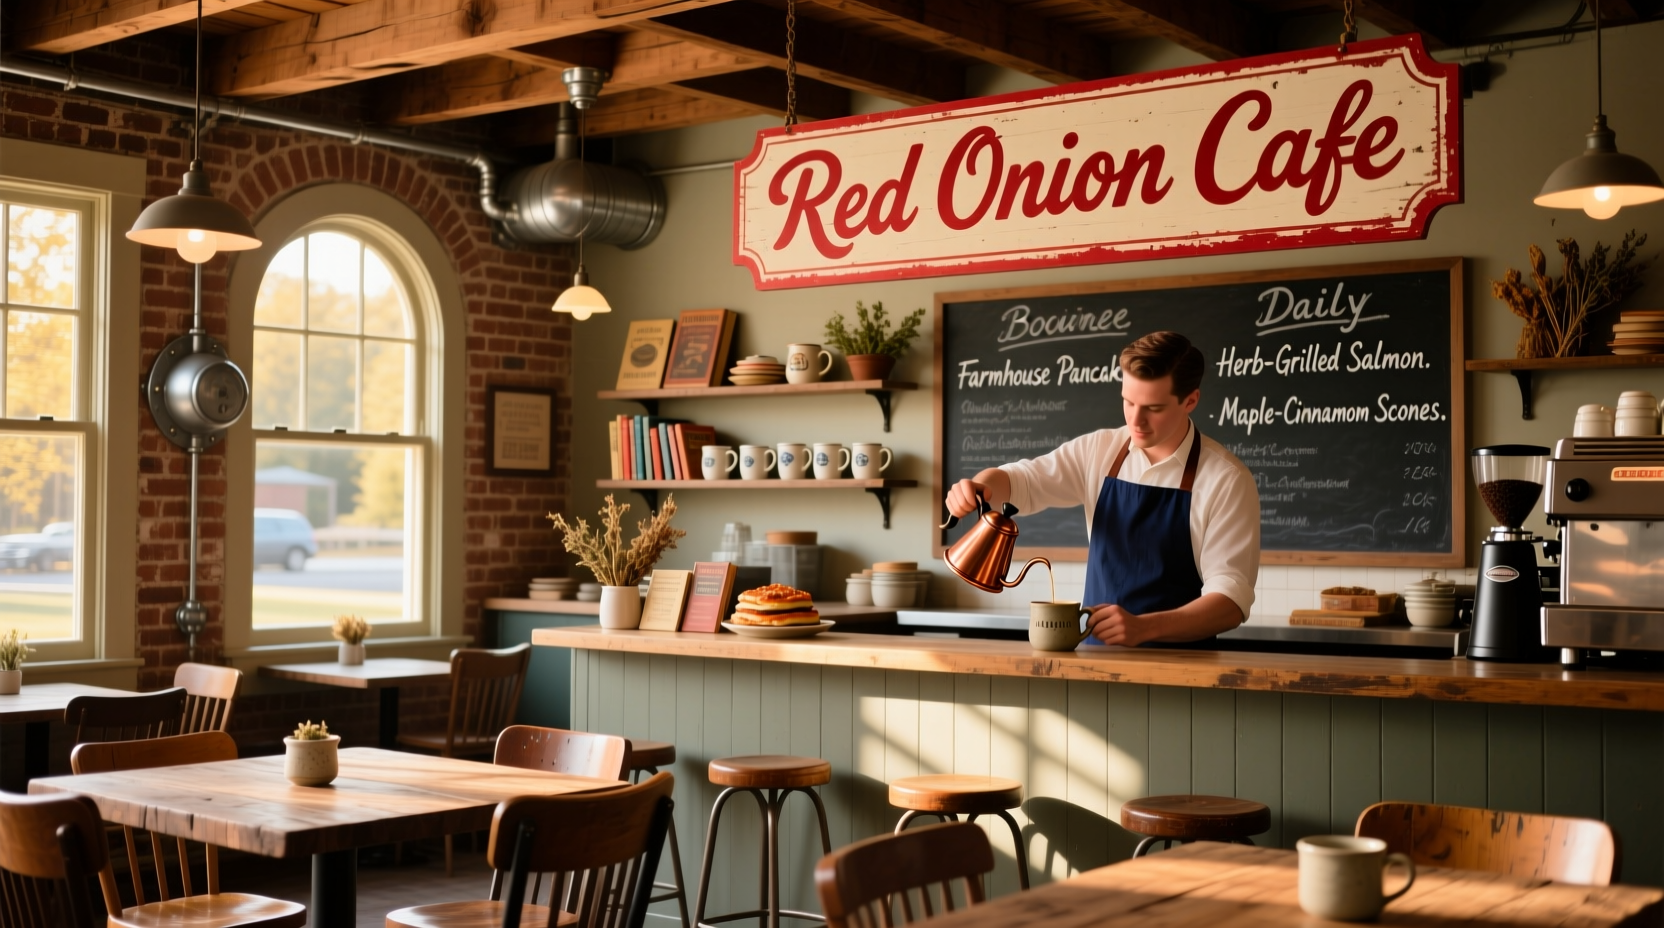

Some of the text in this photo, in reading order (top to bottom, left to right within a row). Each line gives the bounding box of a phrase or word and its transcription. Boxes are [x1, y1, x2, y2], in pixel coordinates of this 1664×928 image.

[768, 79, 1406, 260] Red Onion Cafe
[1255, 282, 1373, 333] Daily
[958, 354, 1123, 389] Farmhouse Pancak
[1216, 340, 1431, 377] Herb-Grilled Salmon.
[1374, 393, 1447, 423] Scones.
